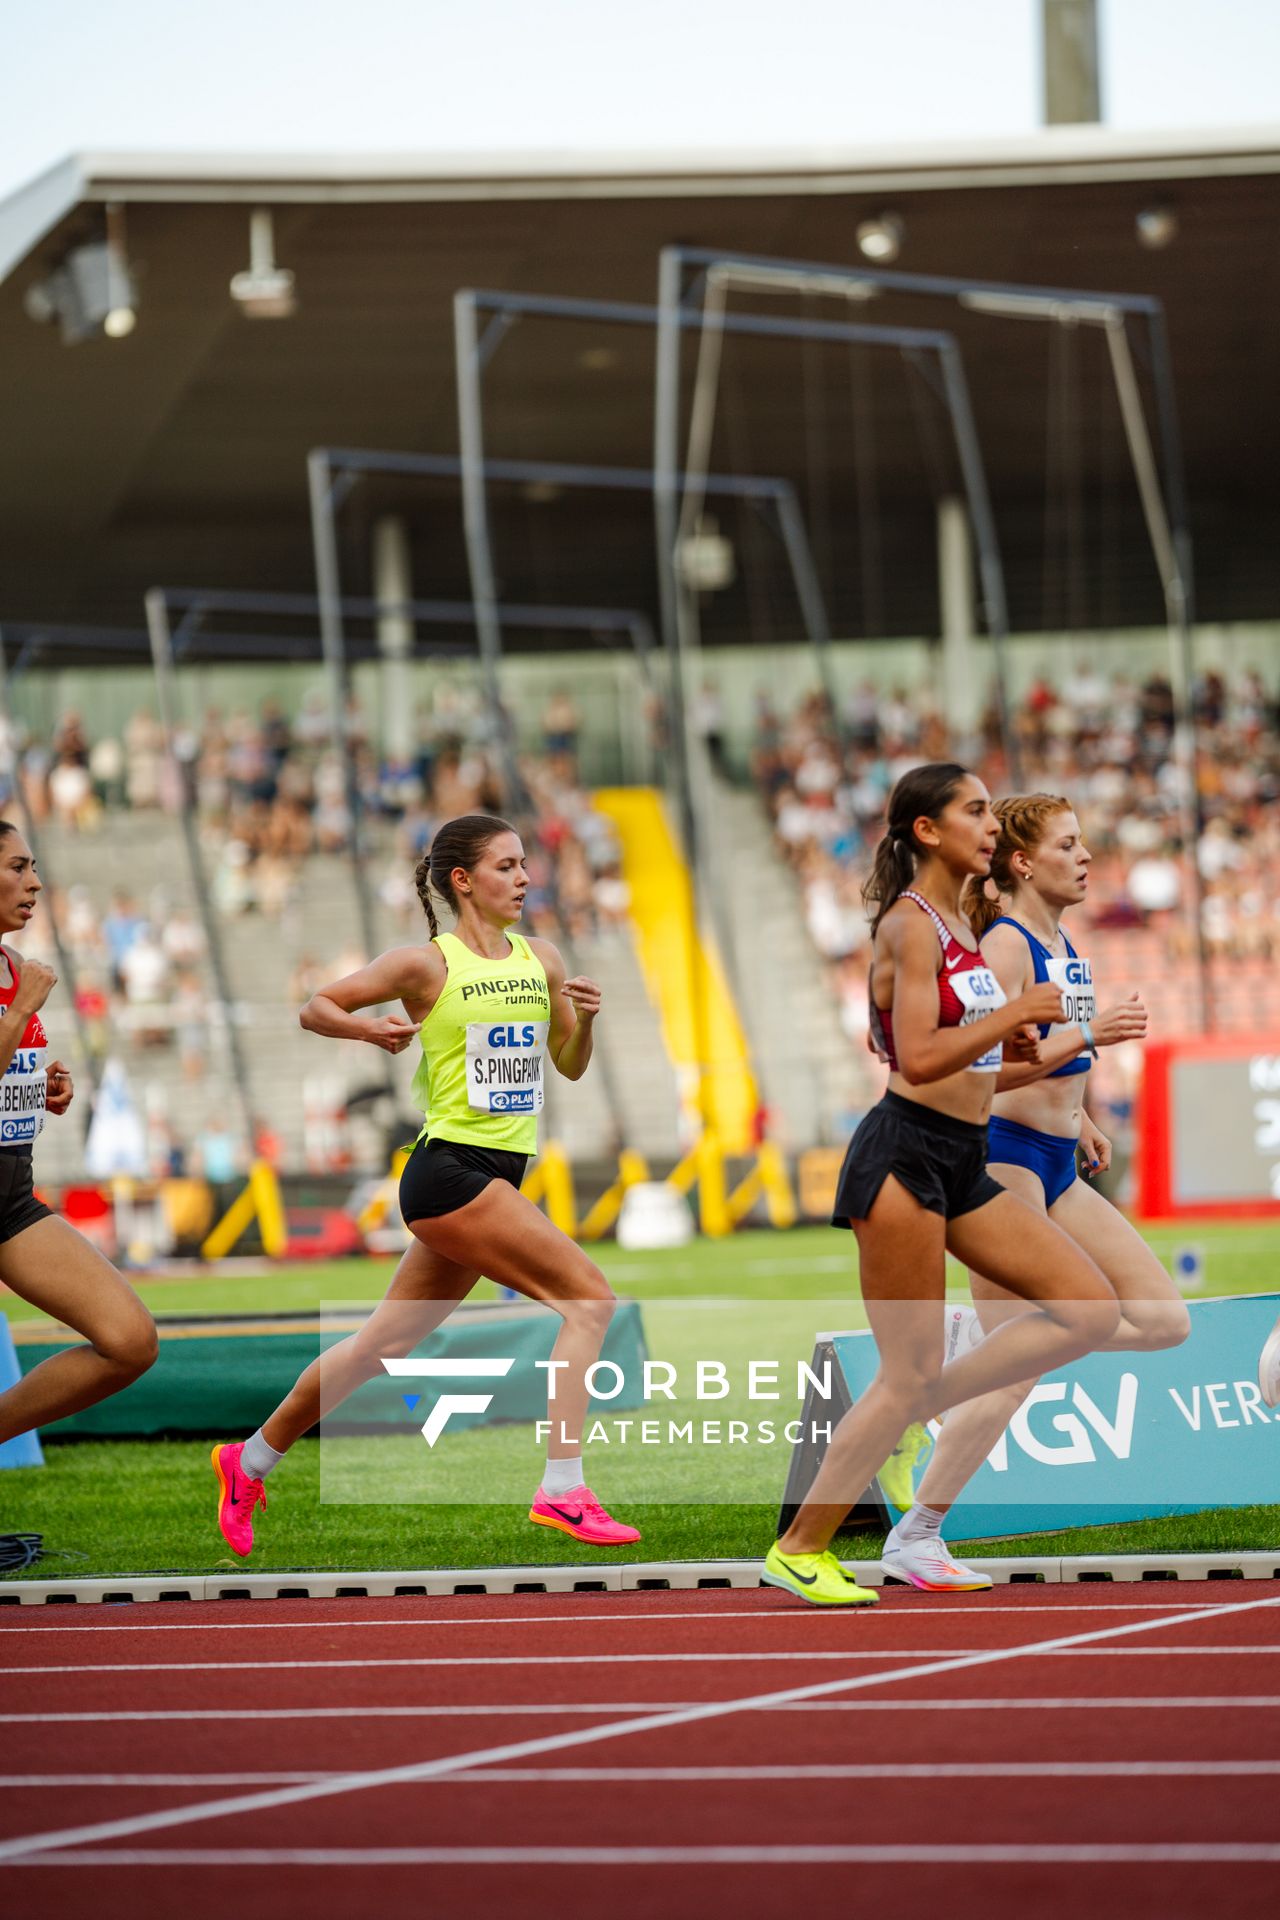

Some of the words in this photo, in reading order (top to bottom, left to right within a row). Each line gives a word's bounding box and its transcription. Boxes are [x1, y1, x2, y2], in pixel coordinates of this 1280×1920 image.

[969, 974, 994, 996] GLS
[505, 993, 548, 1010] running
[511, 1093, 533, 1104] PLAN
[17, 1121, 35, 1133] PLAN
[1168, 1380, 1280, 1431] VER
